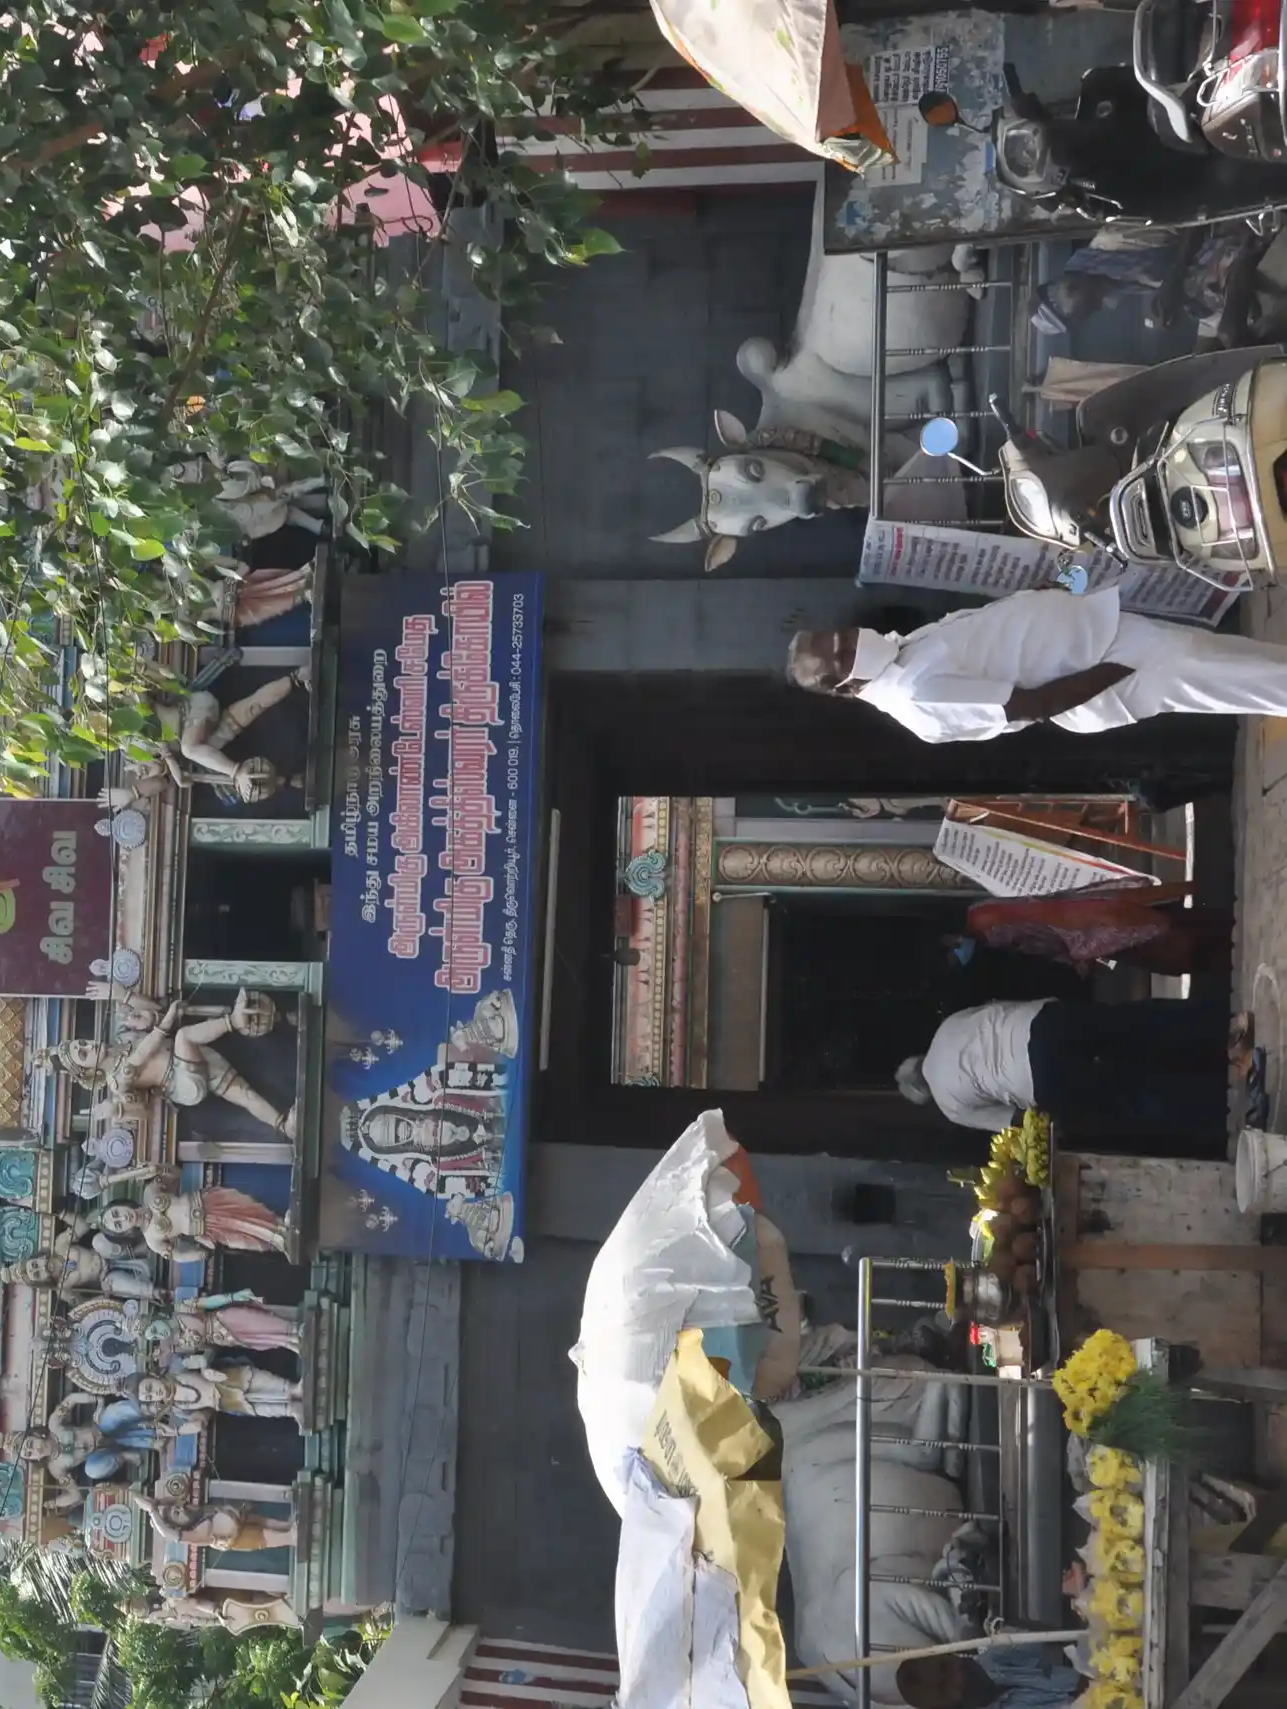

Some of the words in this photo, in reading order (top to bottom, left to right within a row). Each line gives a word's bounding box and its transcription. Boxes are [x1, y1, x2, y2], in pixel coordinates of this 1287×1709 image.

[395, 614, 439, 675] சமேத
[436, 580, 504, 726] திருக்கோயில்
[511, 593, 524, 676] 044-25733703
[346, 714, 362, 763] அரசு
[364, 648, 388, 816] அறநிலையத்துறை
[388, 676, 428, 853] அகிலாண்டேஸ்வரி
[340, 766, 360, 857] தமிழ்நாடு
[428, 725, 502, 875] அகத்தீஸ்வரர்
[508, 767, 518, 790] 600
[365, 821, 379, 866] சமய
[506, 800, 517, 844] சென்னை
[42, 830, 77, 893] சிவ
[360, 870, 380, 923] இந்து
[40, 902, 74, 964] சிவ
[384, 854, 427, 958] அருள்மிகு
[428, 876, 494, 994] அருள்மிகு
